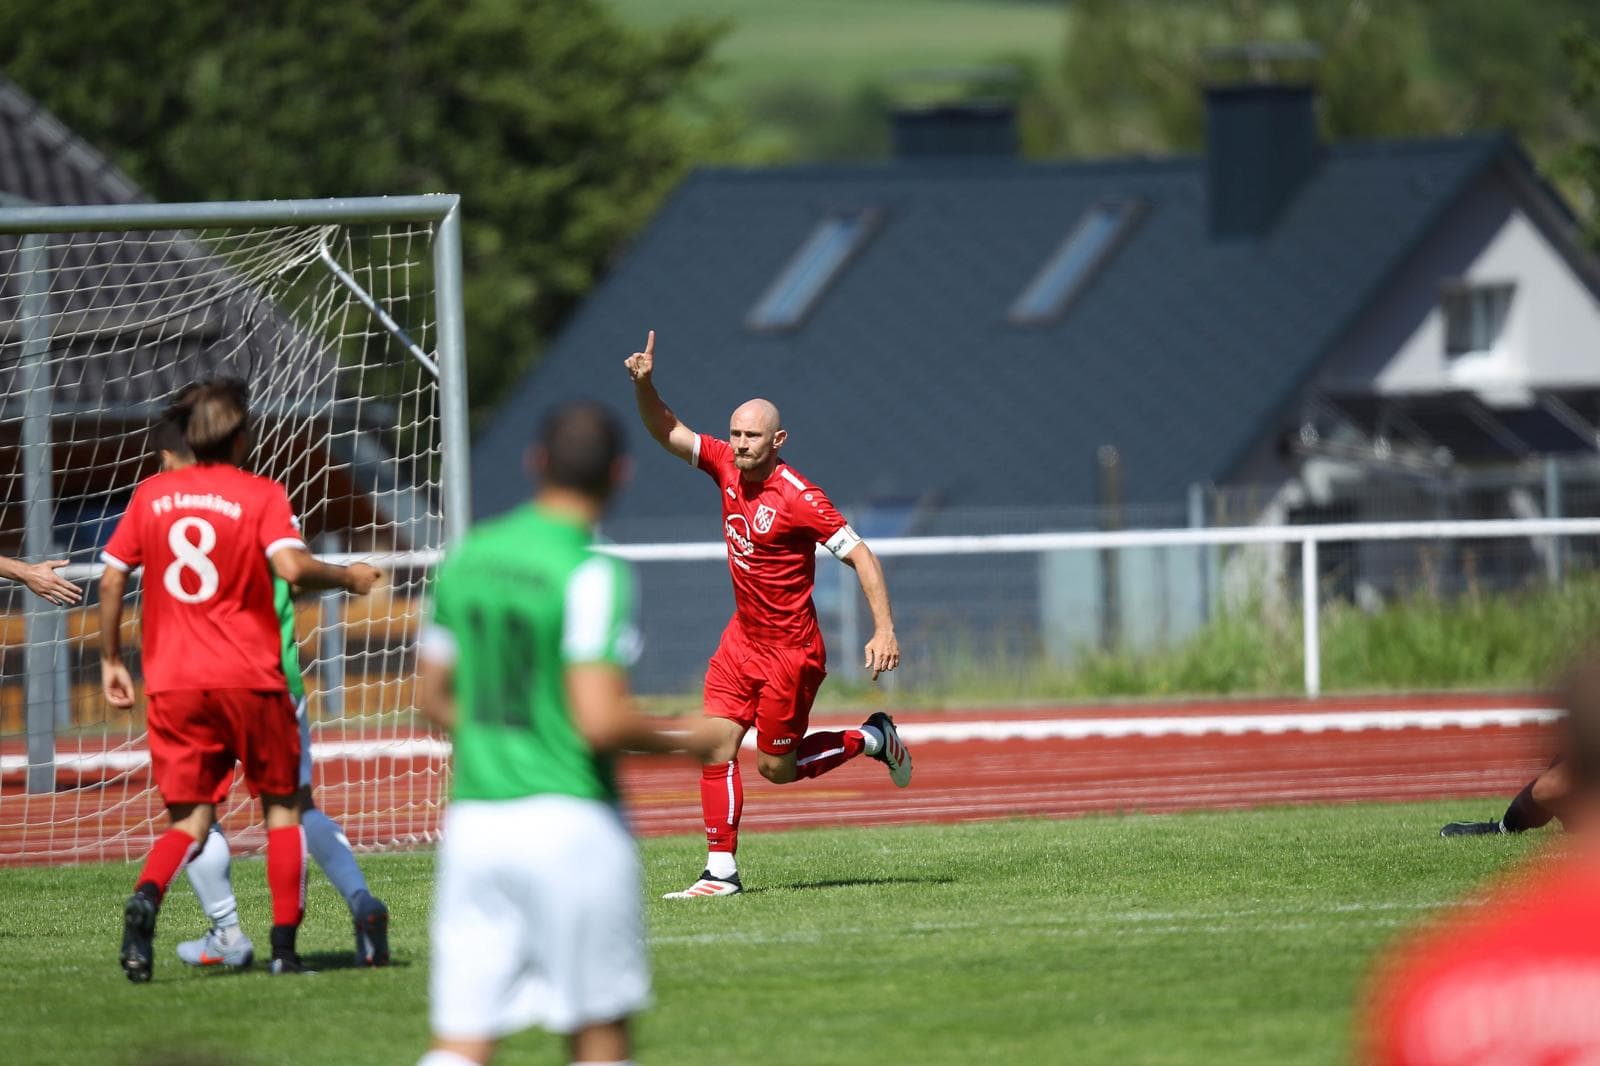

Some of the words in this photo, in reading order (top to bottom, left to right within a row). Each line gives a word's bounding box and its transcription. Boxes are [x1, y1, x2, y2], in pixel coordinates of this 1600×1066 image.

[152, 495, 173, 516] FC
[163, 516, 219, 604] 8
[772, 738, 792, 746] JAKO
